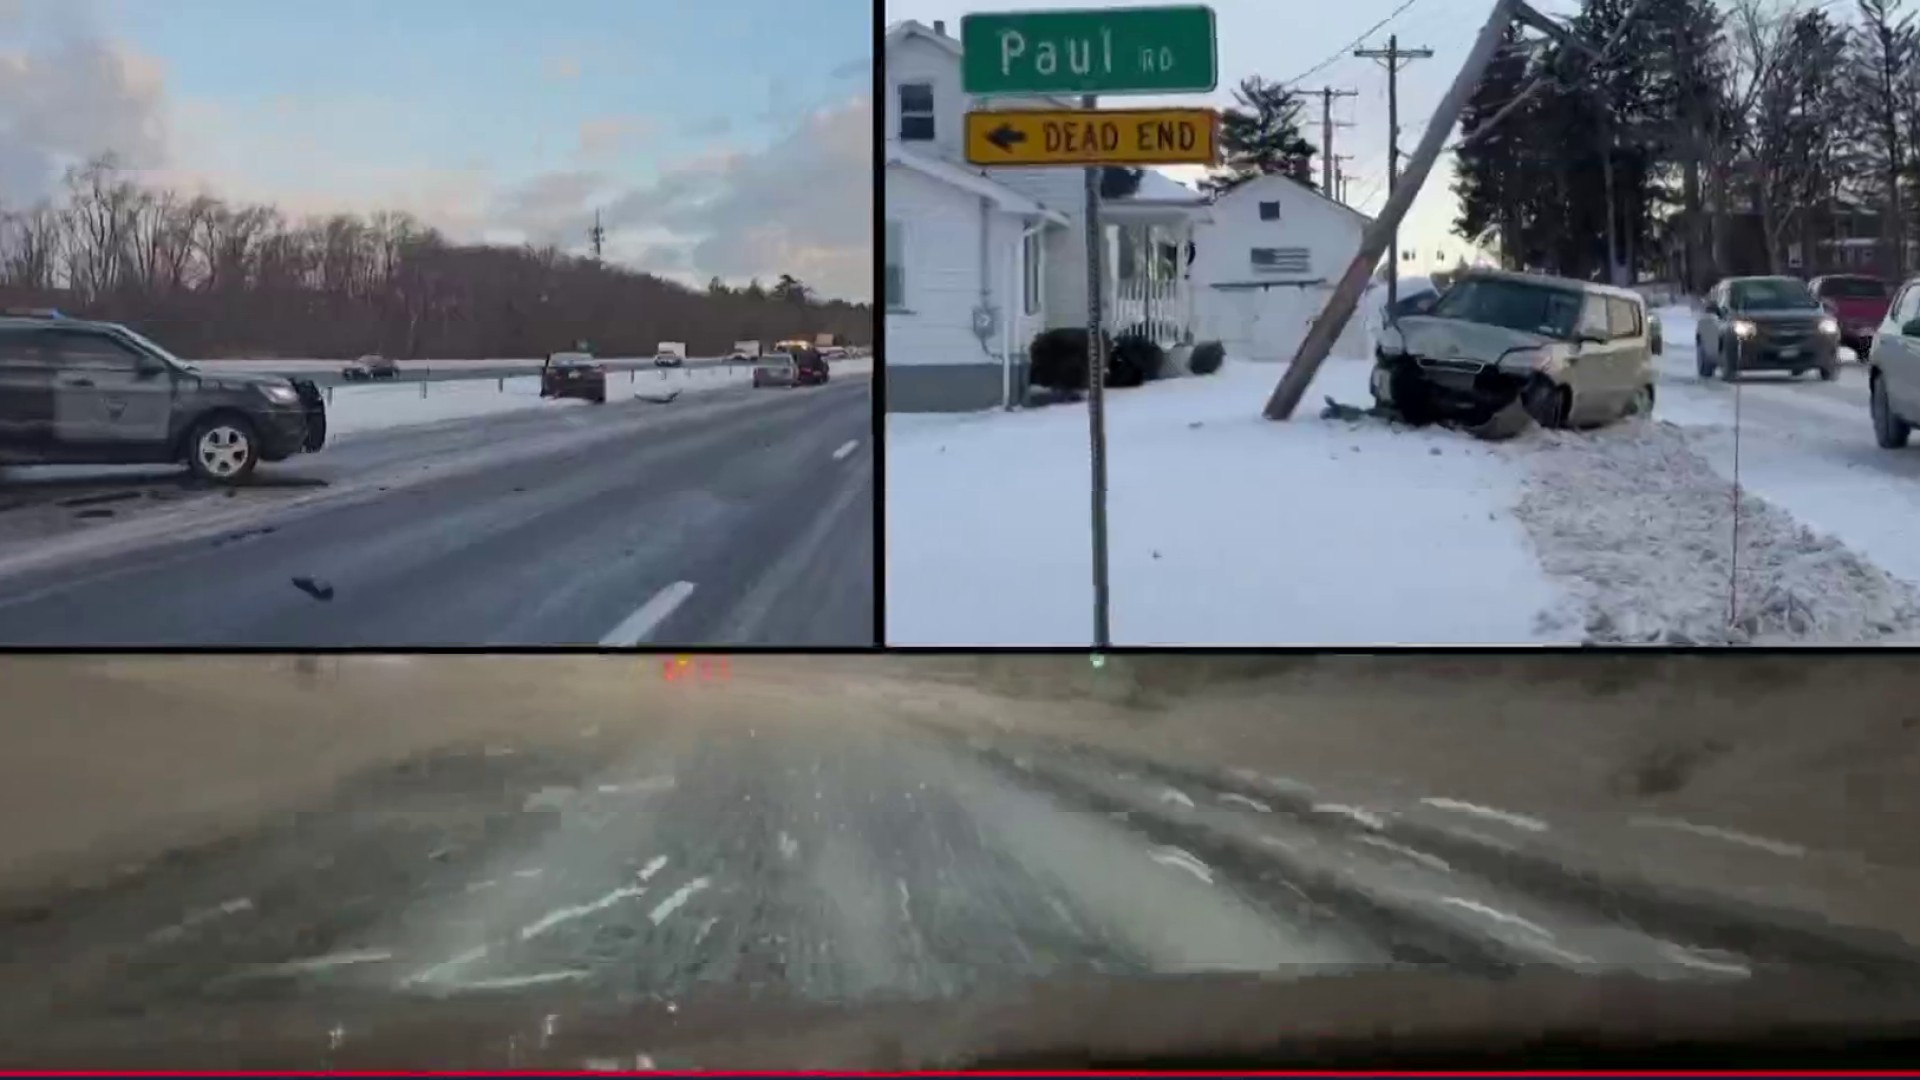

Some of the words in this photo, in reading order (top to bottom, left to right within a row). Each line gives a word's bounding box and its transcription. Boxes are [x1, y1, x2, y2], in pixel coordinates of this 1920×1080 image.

[1000, 29, 1112, 76] Paul
[1139, 46, 1174, 72] RD
[1043, 122, 1118, 152] DEAD
[1137, 121, 1195, 151] END
